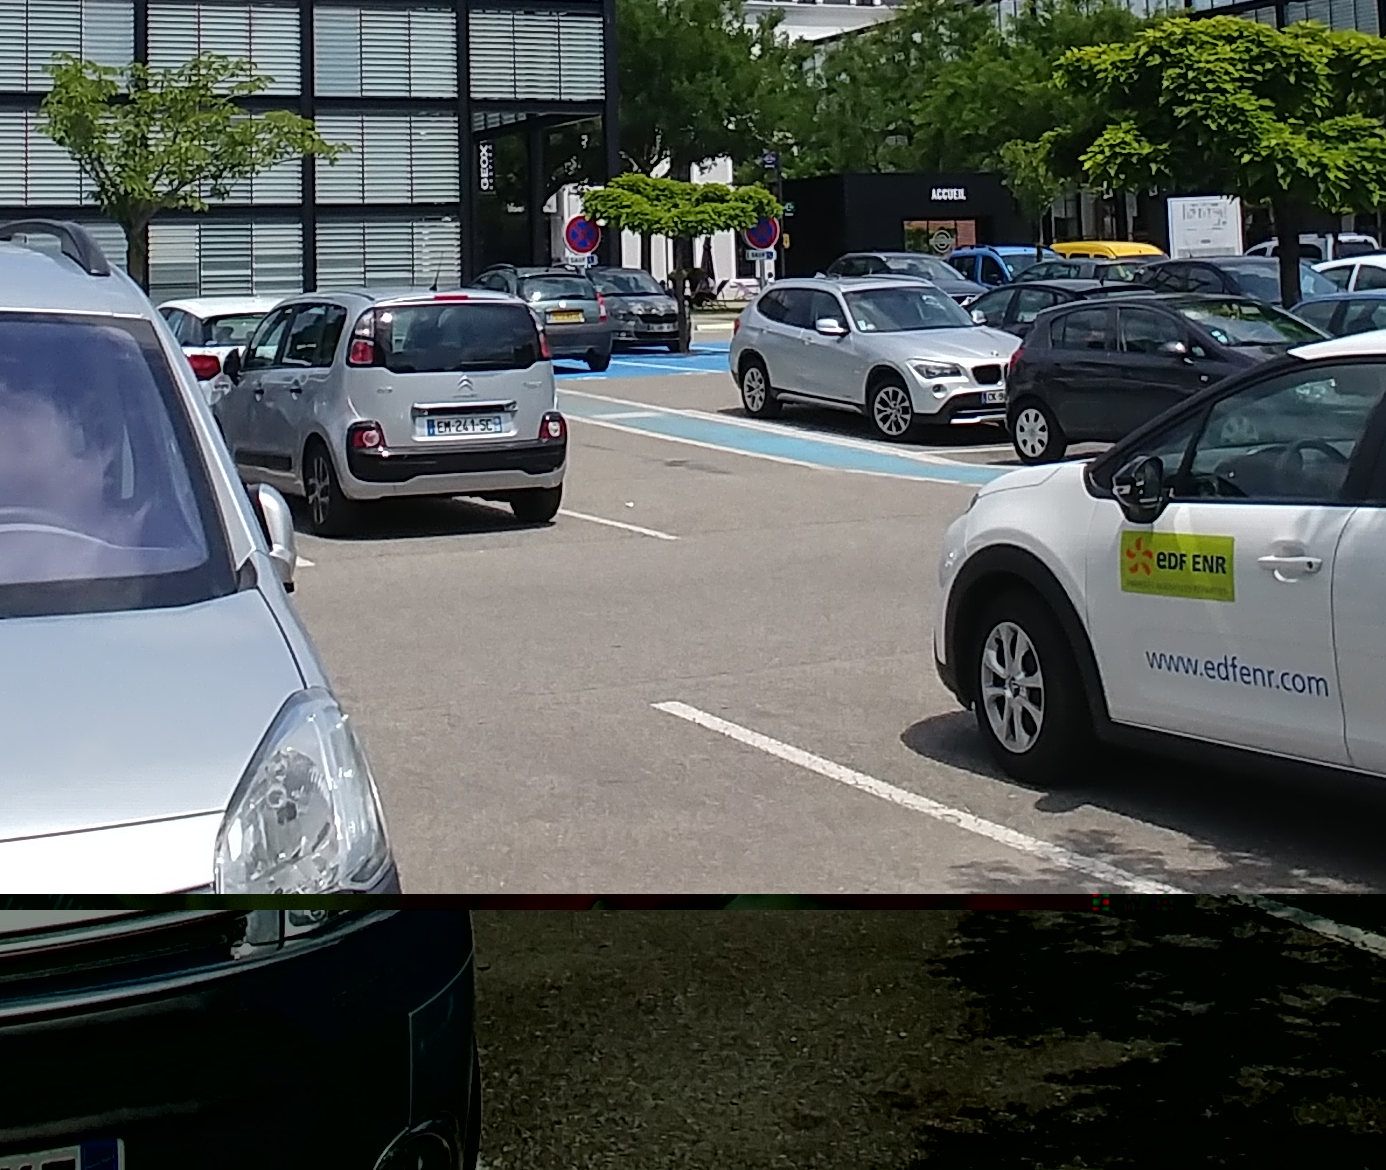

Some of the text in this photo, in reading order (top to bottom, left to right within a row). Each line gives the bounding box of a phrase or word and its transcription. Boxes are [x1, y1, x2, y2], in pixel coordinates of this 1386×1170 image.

[479, 144, 489, 190] GEOX
[931, 188, 966, 201] ACCUEIL
[1191, 553, 1227, 575] ENR
[1145, 650, 1330, 698] www.edfenr.com
